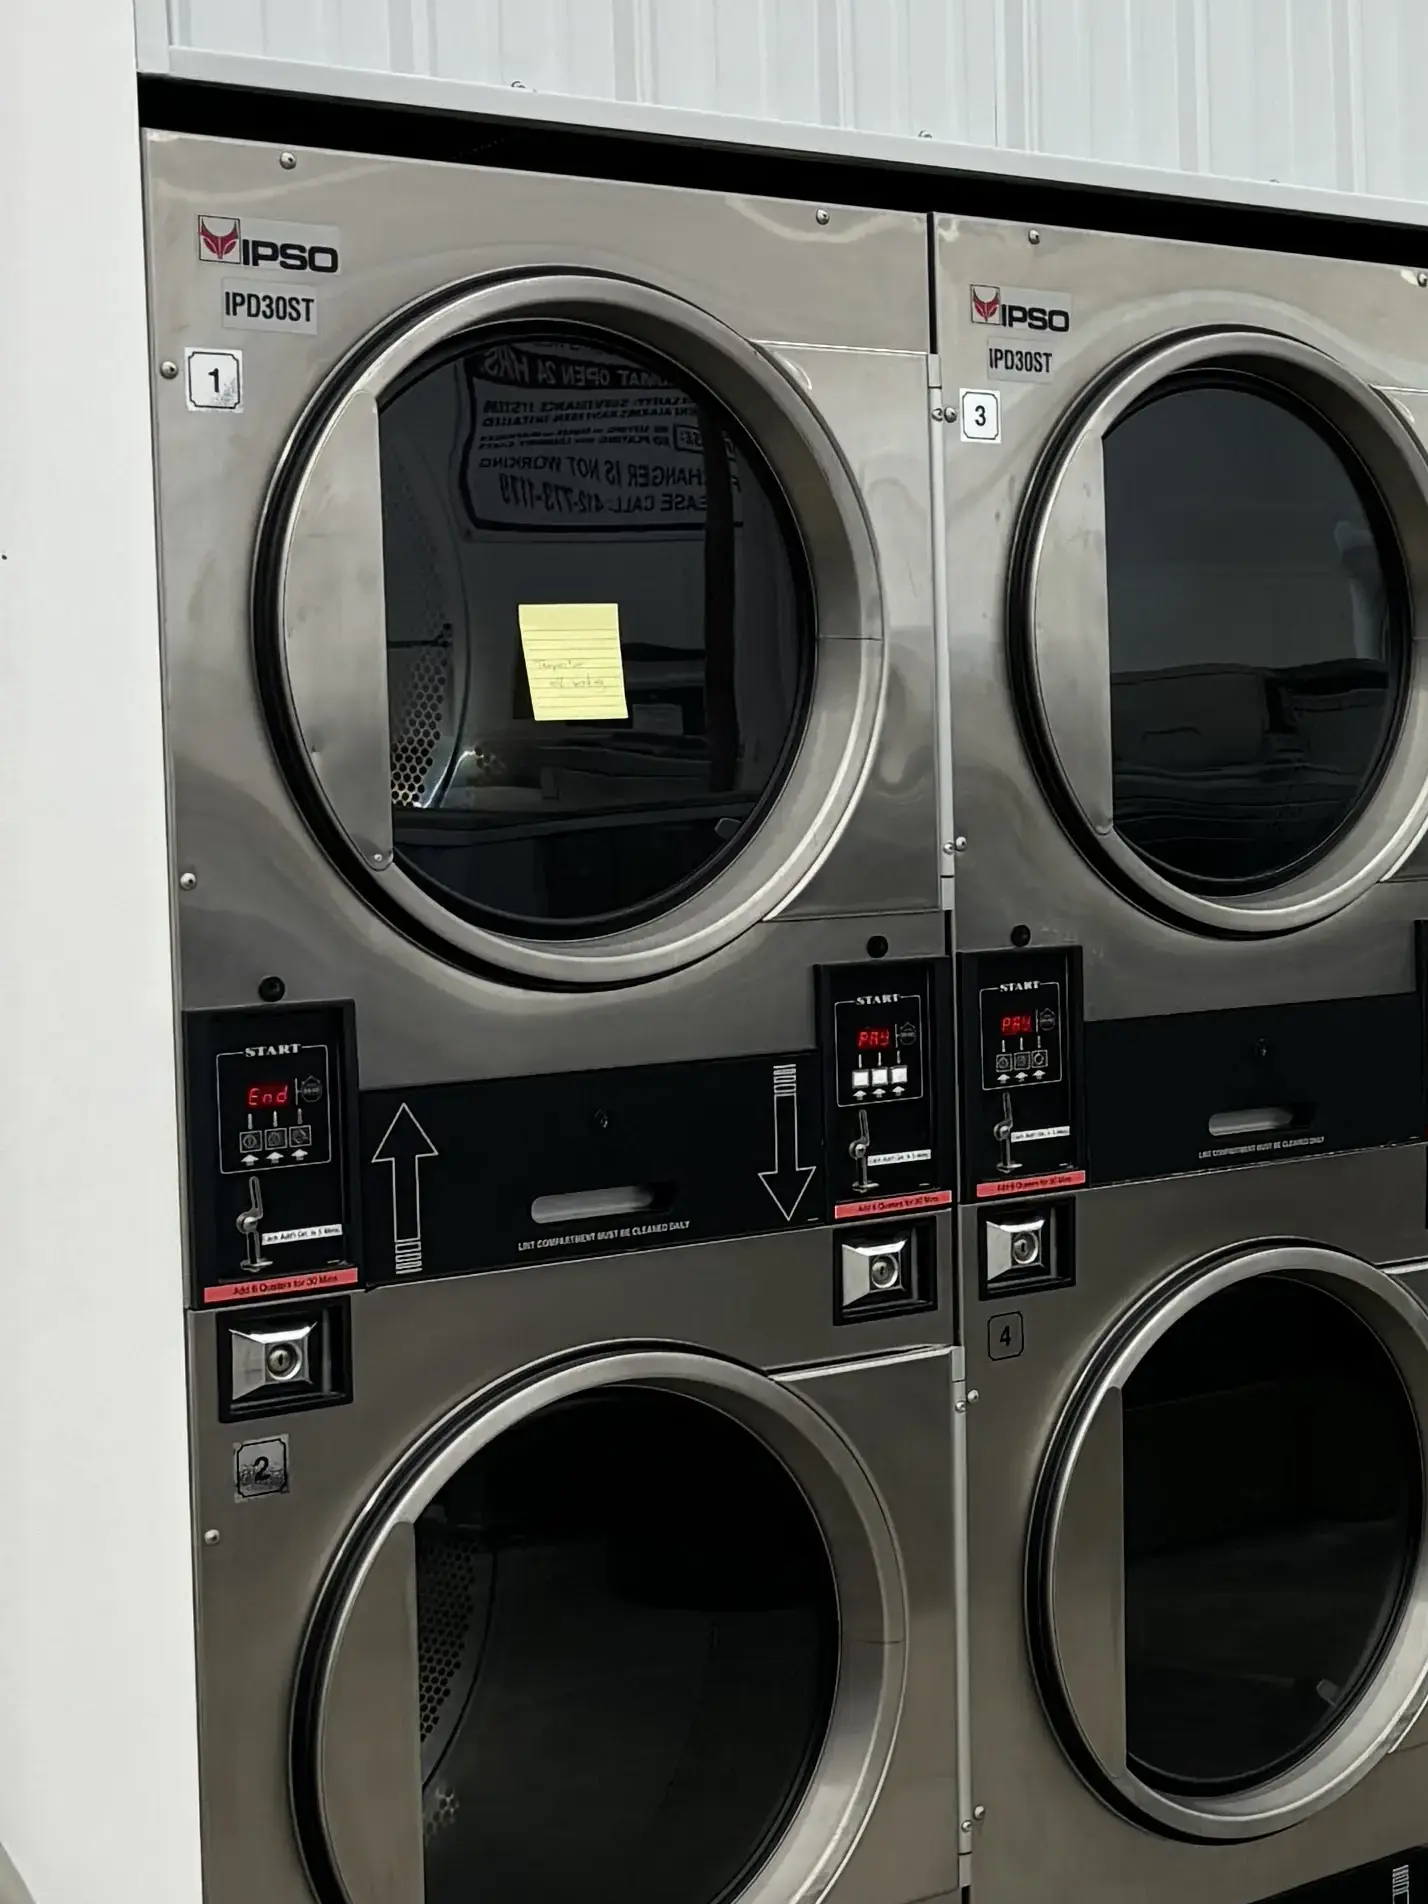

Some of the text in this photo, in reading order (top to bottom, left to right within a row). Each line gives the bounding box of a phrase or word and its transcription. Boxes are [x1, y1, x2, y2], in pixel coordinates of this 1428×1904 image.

[242, 238, 339, 273] IPSO
[225, 291, 315, 322] IPD30ST
[1001, 304, 1070, 332] IPSO
[989, 348, 1052, 373] IPD30ST
[208, 368, 220, 393] 1
[974, 405, 987, 426] 3
[1000, 981, 1040, 992] START
[856, 993, 900, 1005] START
[244, 1044, 300, 1057] START
[249, 1085, 288, 1106] End
[597, 1229, 618, 1240] MUST
[620, 1227, 630, 1237] BE
[632, 1223, 667, 1235] CLEANED
[234, 1286, 250, 1295] Add
[260, 1281, 291, 1293] Quarters
[306, 1276, 317, 1285] 30
[1000, 1325, 1011, 1346] 4
[253, 1456, 271, 1483] 2
